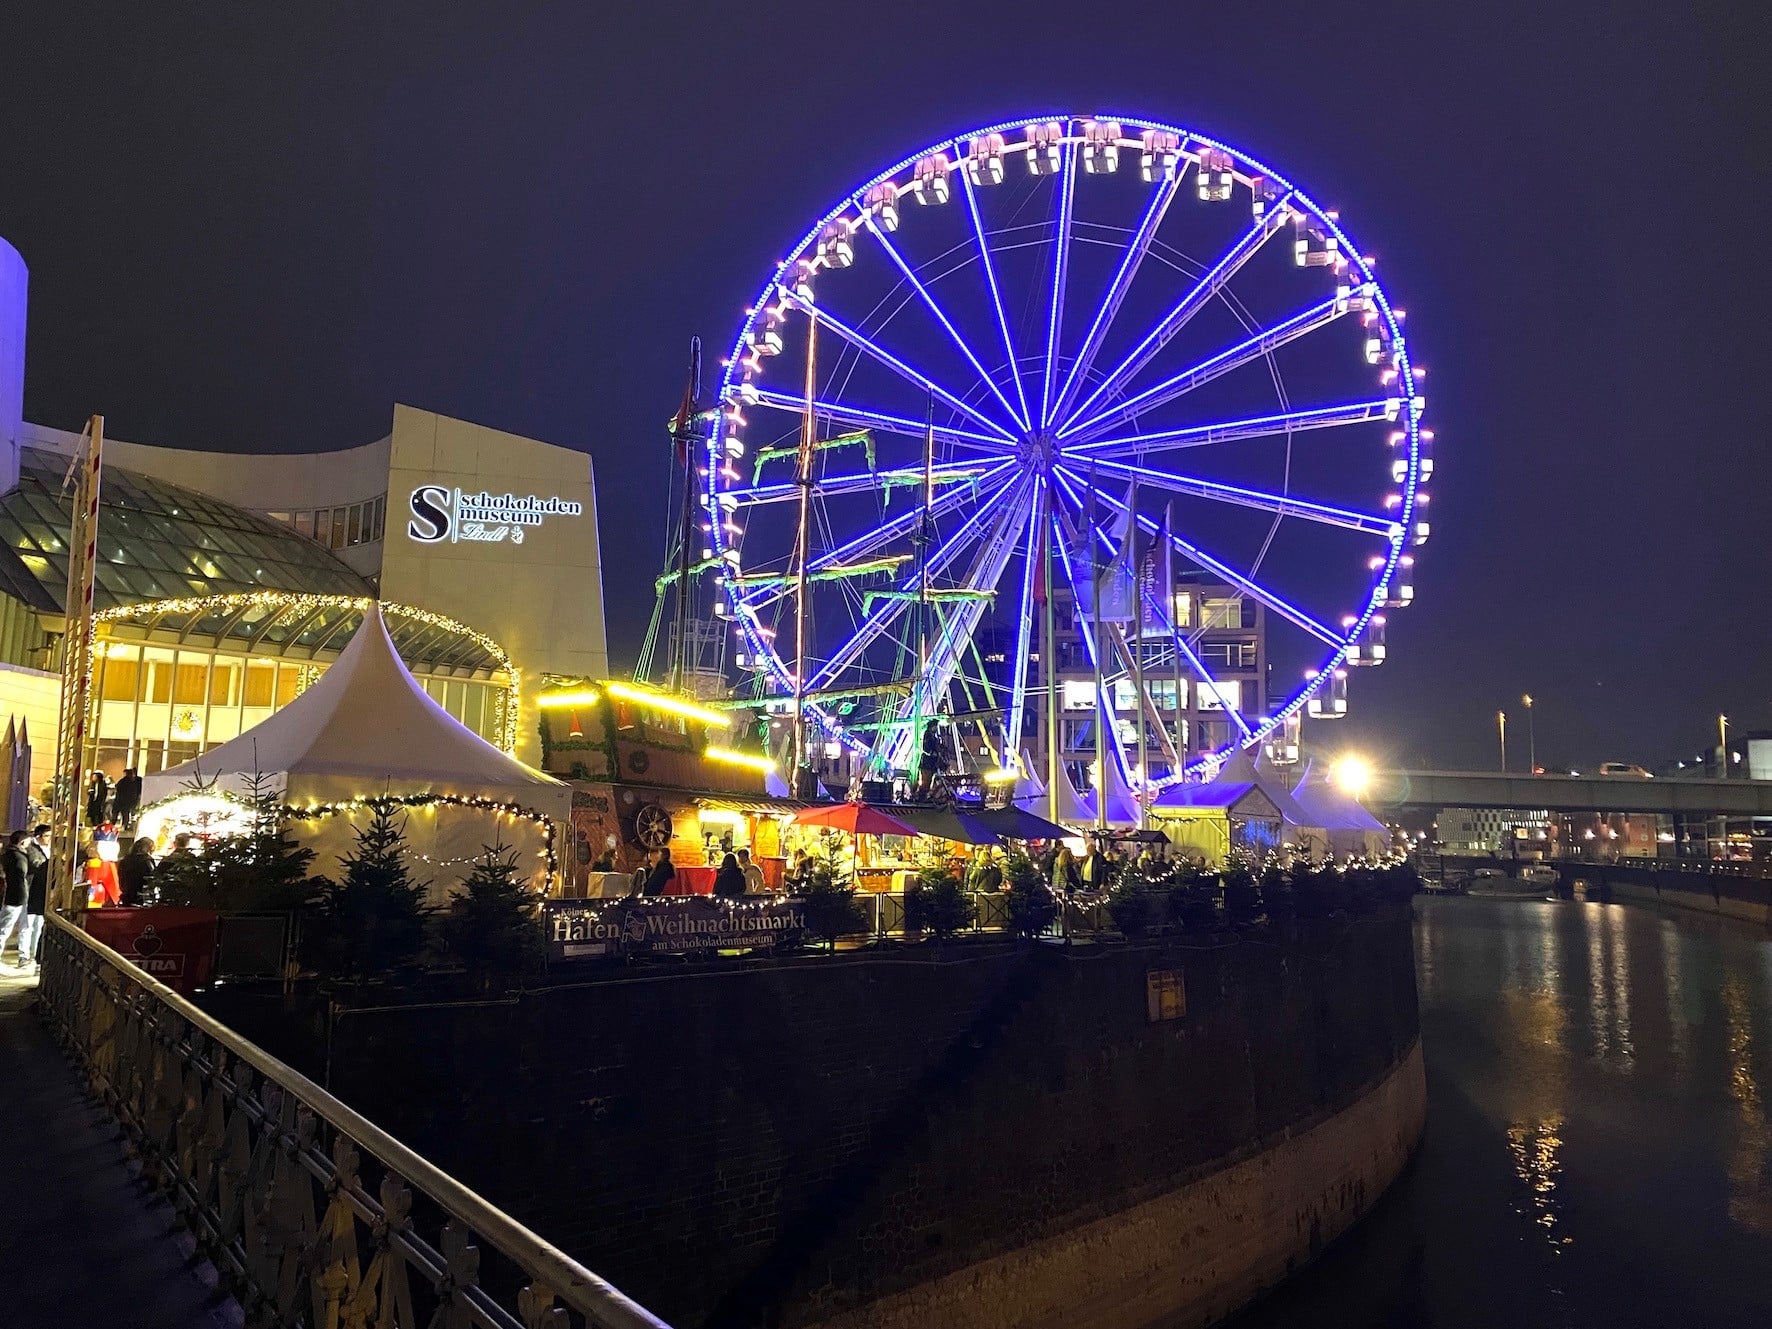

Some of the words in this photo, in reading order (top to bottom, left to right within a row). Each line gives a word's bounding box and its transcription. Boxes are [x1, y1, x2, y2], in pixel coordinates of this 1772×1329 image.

[459, 492, 582, 515] schokoladen
[459, 508, 542, 525] museum
[552, 916, 621, 942] Hafen
[646, 908, 806, 935] Weihnachtsmarkt
[652, 940, 669, 951] am
[670, 934, 773, 950] Schokoladenmuseum
